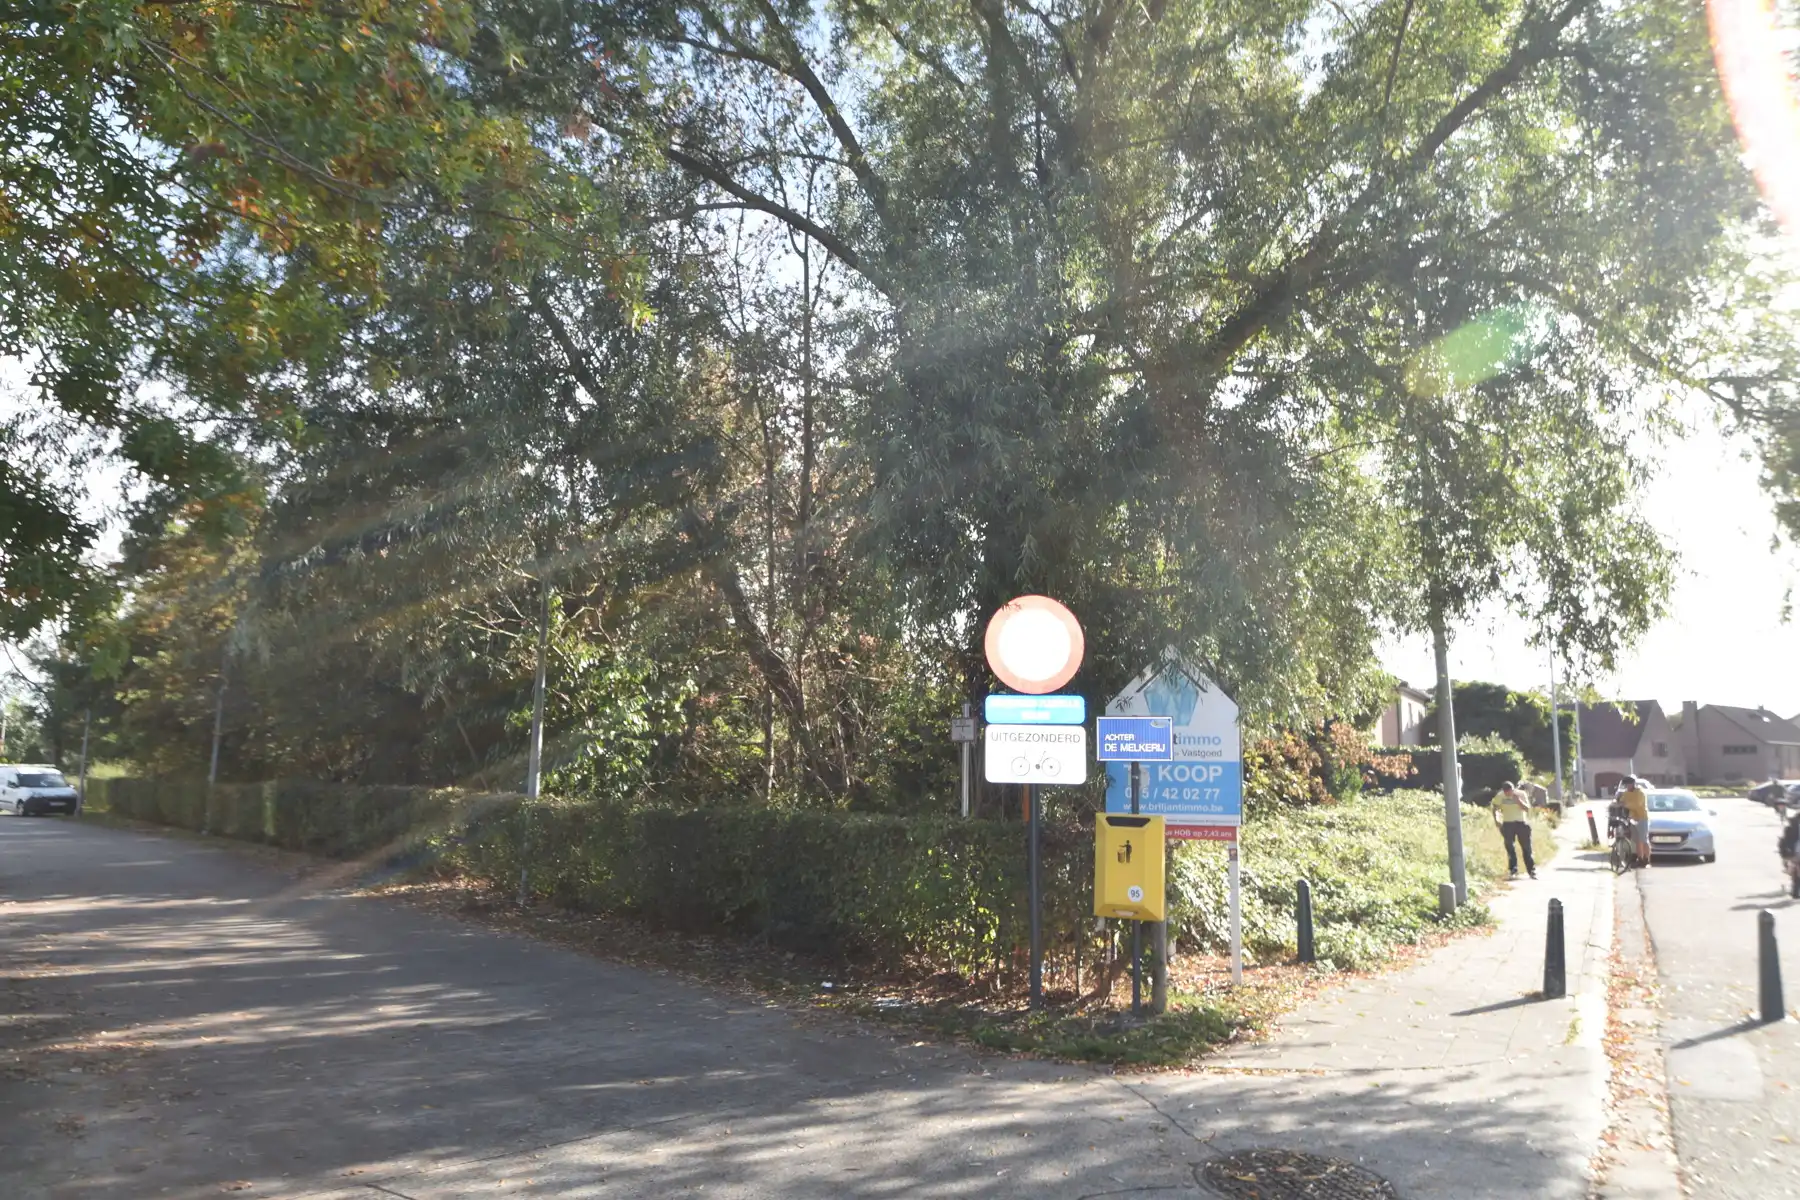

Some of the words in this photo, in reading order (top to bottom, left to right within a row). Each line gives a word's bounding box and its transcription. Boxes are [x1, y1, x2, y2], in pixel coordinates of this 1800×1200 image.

[991, 732, 1081, 743] UITGEZONDERD
[1104, 733, 1135, 741] ACHTER
[1104, 743, 1118, 752] DE
[1120, 743, 1166, 753] MELKERIJ
[1181, 749, 1222, 759] Vastgoed
[1158, 764, 1223, 783] KOOP
[1125, 787, 1149, 799] 05
[1162, 788, 1178, 800] 42
[1183, 788, 1200, 800] 02
[1204, 789, 1220, 801] 77
[1123, 802, 1223, 812] ww.briljantimmo.be
[1130, 889, 1140, 898] 95
